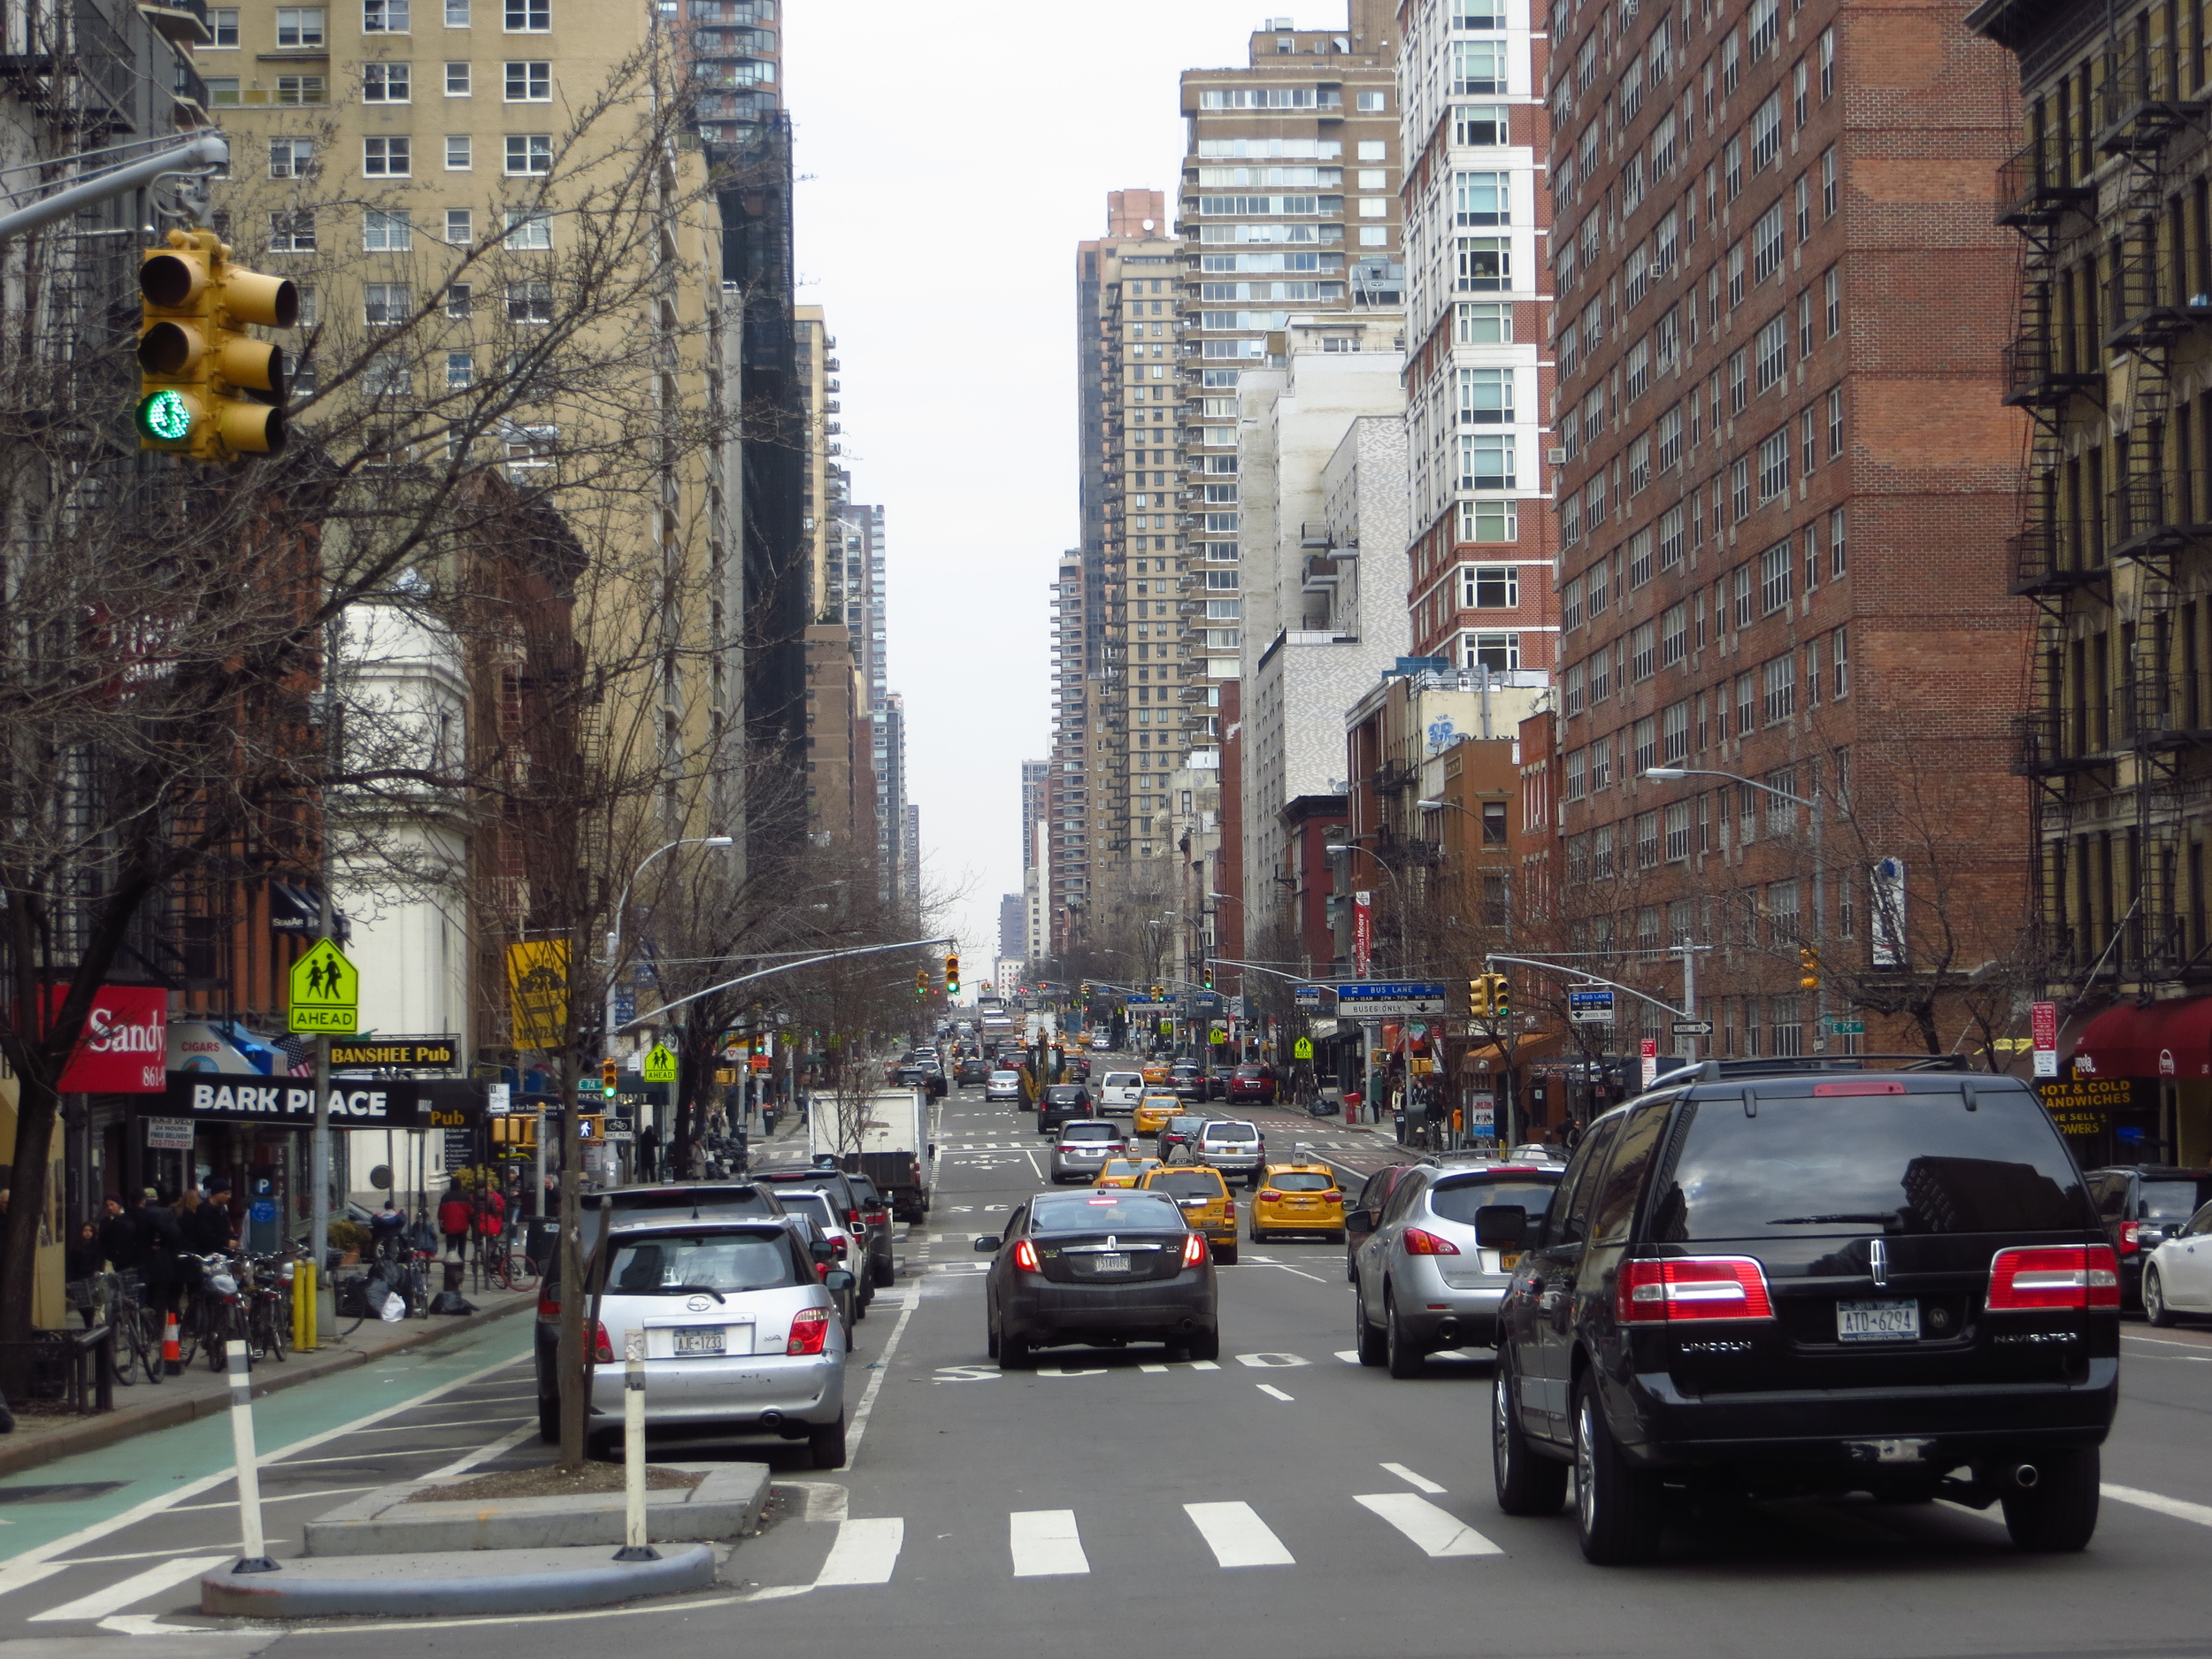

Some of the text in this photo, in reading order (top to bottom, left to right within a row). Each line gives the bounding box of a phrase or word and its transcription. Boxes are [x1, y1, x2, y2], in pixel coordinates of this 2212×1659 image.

[296, 1012, 353, 1025] AHEAD
[1832, 1023, 1838, 1033] E
[1842, 1023, 1852, 1033] 74
[181, 1041, 220, 1052] CIGARS
[331, 1047, 450, 1064] BANSHEE Pub
[579, 1080, 584, 1089] E
[587, 1080, 595, 1089] 74
[2073, 1083, 2084, 1094] &
[2087, 1080, 2131, 1093] COLD
[193, 1084, 280, 1112] BARK
[2041, 1093, 2131, 1108] ANDWICHES
[430, 1110, 465, 1125] Pub
[2059, 1123, 2100, 1134] OWERS
[259, 1179, 269, 1193] P
[1993, 1333, 2078, 1343] NAVIGATOR
[1681, 1341, 1751, 1352] LINCOLN
